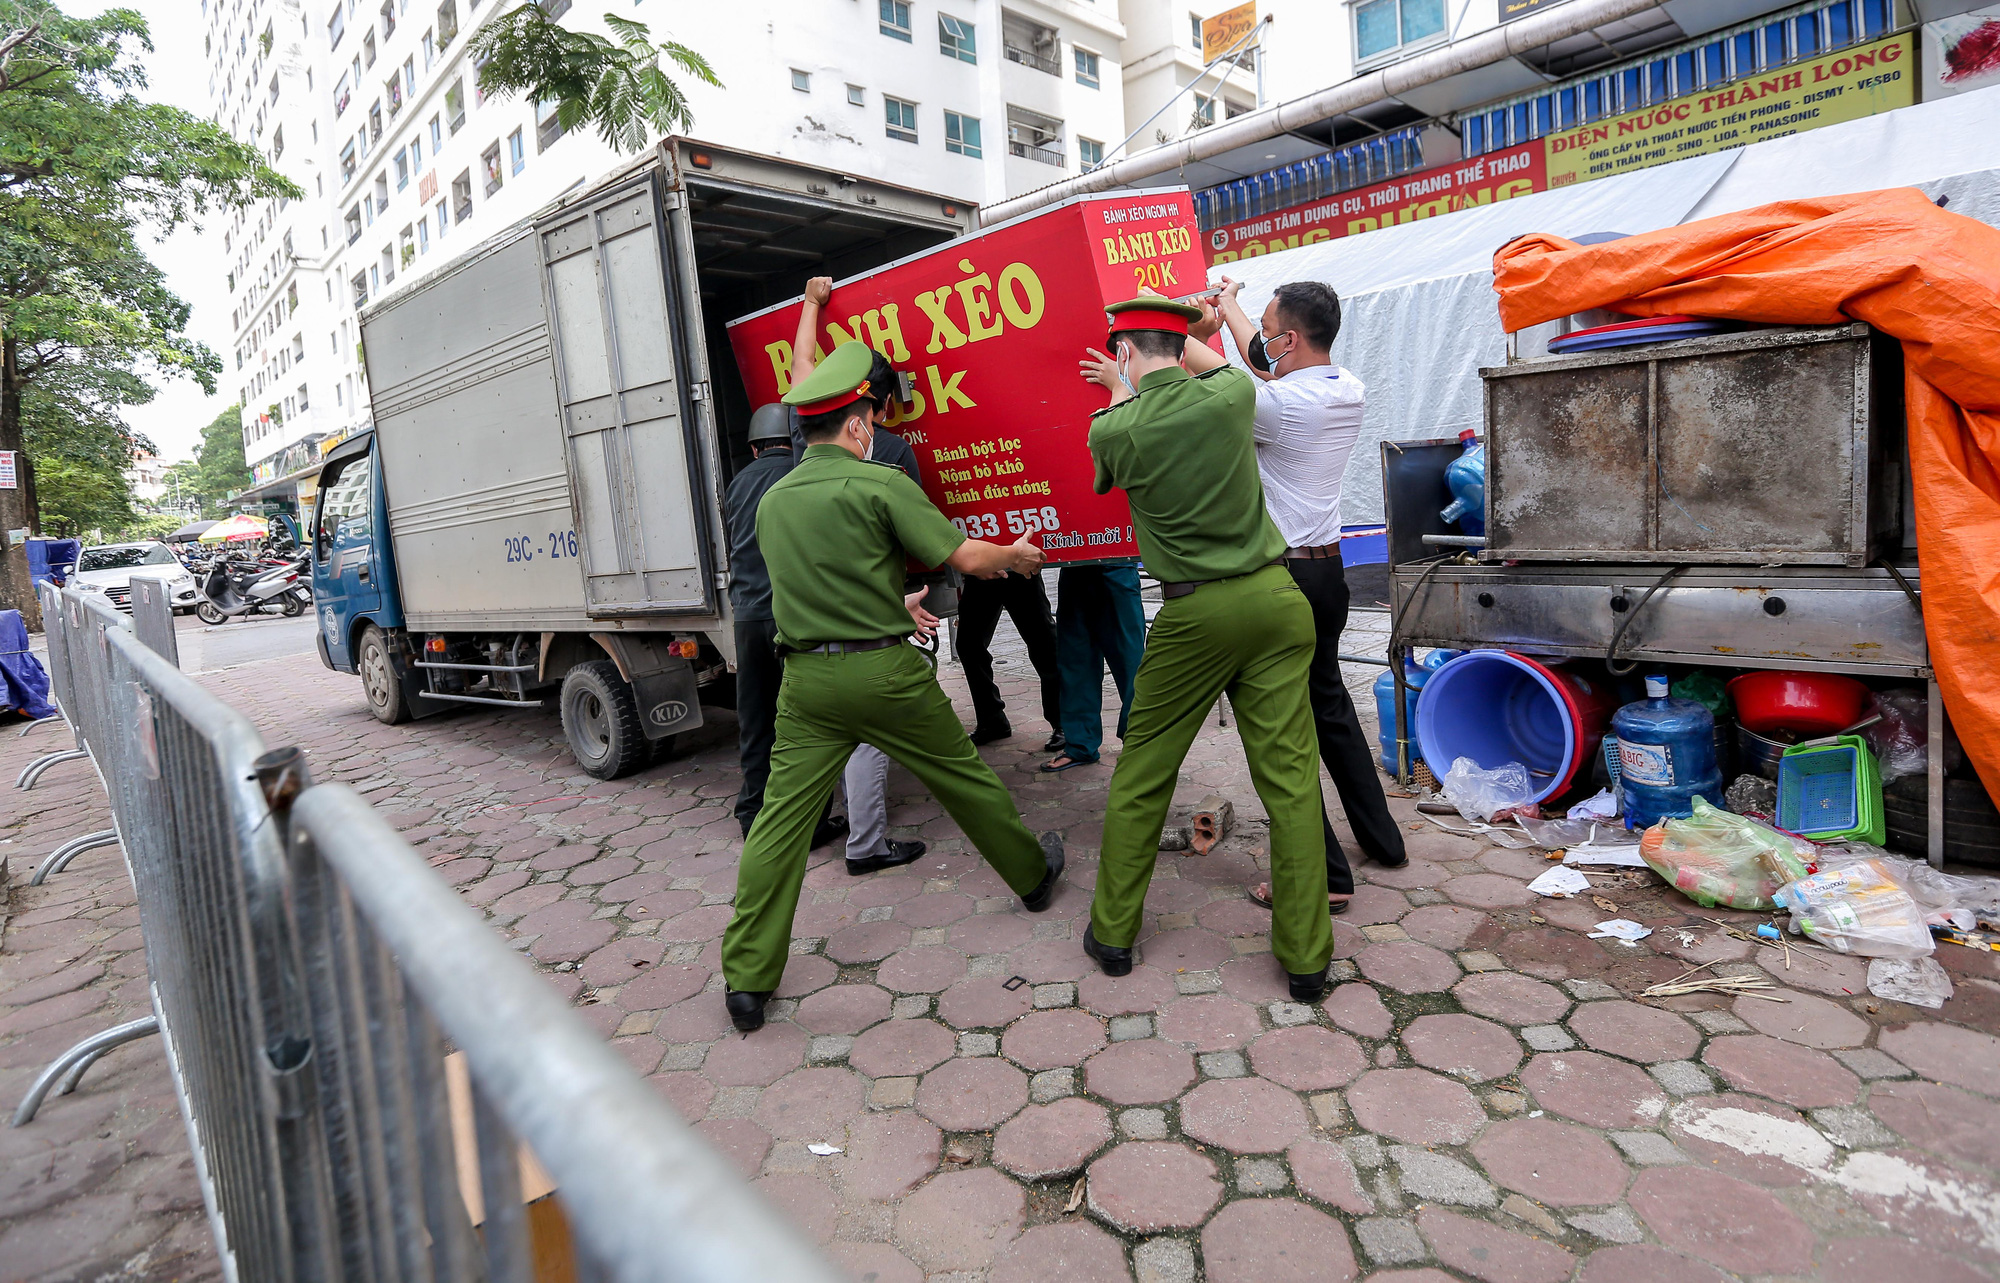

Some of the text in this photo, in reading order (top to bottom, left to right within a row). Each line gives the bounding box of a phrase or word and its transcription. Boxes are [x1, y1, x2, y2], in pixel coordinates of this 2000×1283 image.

[1206, 14, 1252, 47] Spa
[1551, 43, 1903, 153] ĐIỆN NƯỚC THÀNH LONG
[1750, 100, 1792, 119] PHONG
[1803, 85, 1845, 105] DISMY
[1857, 70, 1901, 91] VESBO
[1676, 138, 1703, 153] SINO
[1714, 129, 1739, 143] LIOA
[1750, 108, 1820, 134] PANASONIC
[1233, 220, 1272, 241] TRUNG
[1274, 212, 1301, 230] TÂM
[1304, 202, 1339, 224] DỤNG
[1368, 185, 1399, 208] THỜI
[1403, 173, 1451, 198] TRANG
[1455, 157, 1485, 186] THỂ
[1488, 151, 1531, 177] THAO
[1103, 203, 1179, 225] BÁNH XÈO NGON HH
[1103, 221, 1191, 265] BÁNH XÈO
[1134, 260, 1178, 291] 20K
[765, 258, 1045, 396] BNH XÈO
[933, 437, 1022, 463] Bánh bột lọc
[938, 457, 1025, 486] Nộm bò khô
[945, 479, 1051, 505] Bánh đúc nóng
[1005, 506, 1061, 535] 558
[504, 535, 533, 563] 29C
[549, 530, 578, 558] 216
[1042, 530, 1084, 550] Kính
[1088, 526, 1121, 546] mời
[655, 704, 682, 722] KIA
